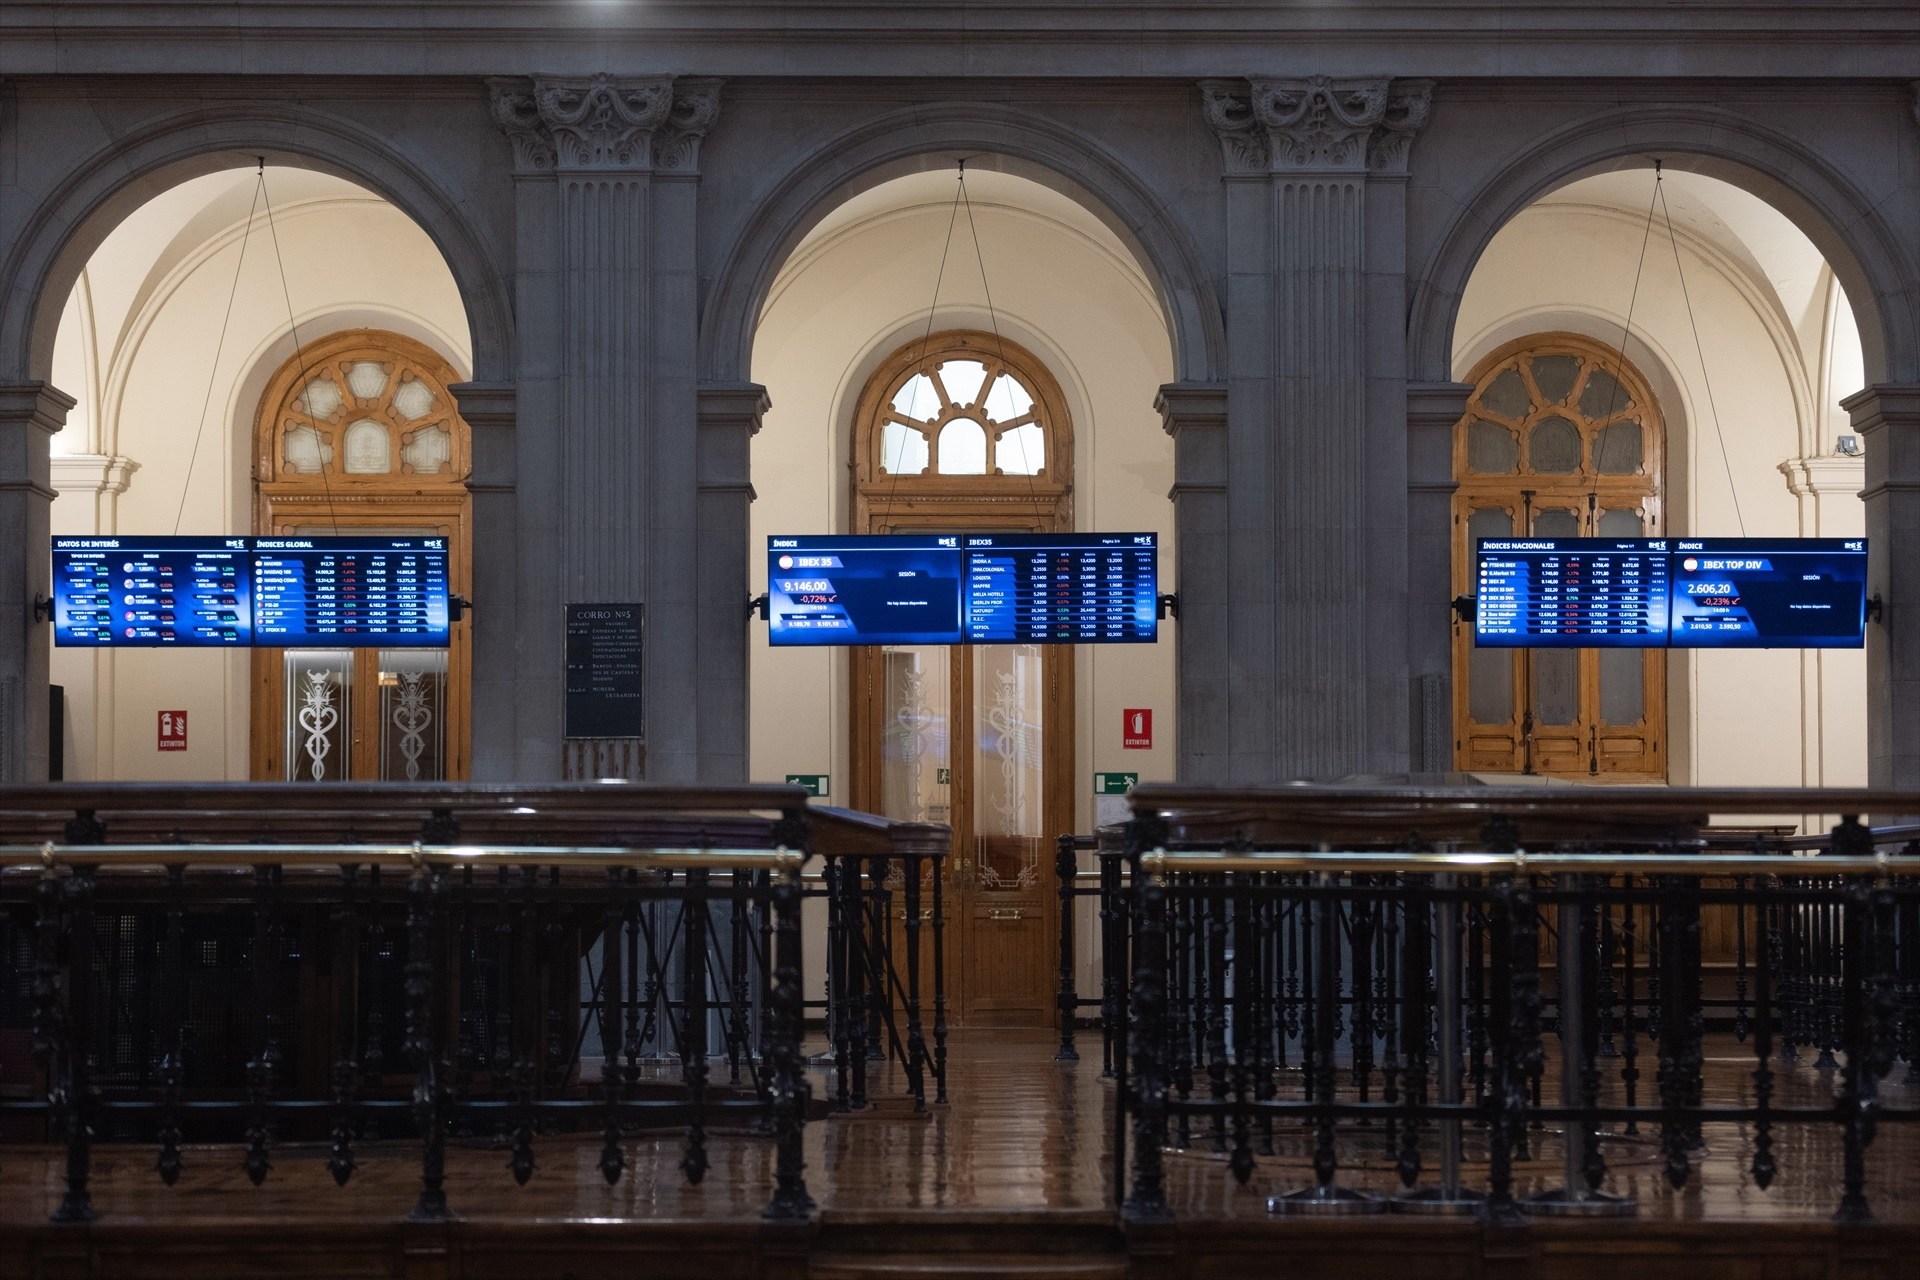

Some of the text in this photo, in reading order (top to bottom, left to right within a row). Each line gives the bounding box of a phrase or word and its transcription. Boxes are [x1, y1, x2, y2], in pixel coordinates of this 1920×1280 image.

[57, 540, 80, 548] DATOS
[91, 540, 120, 548] INTERÉS
[256, 540, 285, 548] ÍNDICES
[773, 539, 798, 547] ÍNDICE
[1483, 541, 1511, 549] ÍNDICES
[798, 558, 832, 566] IBEX 35
[1703, 561, 1762, 569] IBEX TOP DIV
[784, 582, 827, 592] 9.146,00
[1687, 584, 1730, 595] 2.606,20
[800, 595, 826, 604] -0,72%
[1703, 598, 1730, 606] -0,23%
[577, 611, 611, 619] CORRO
